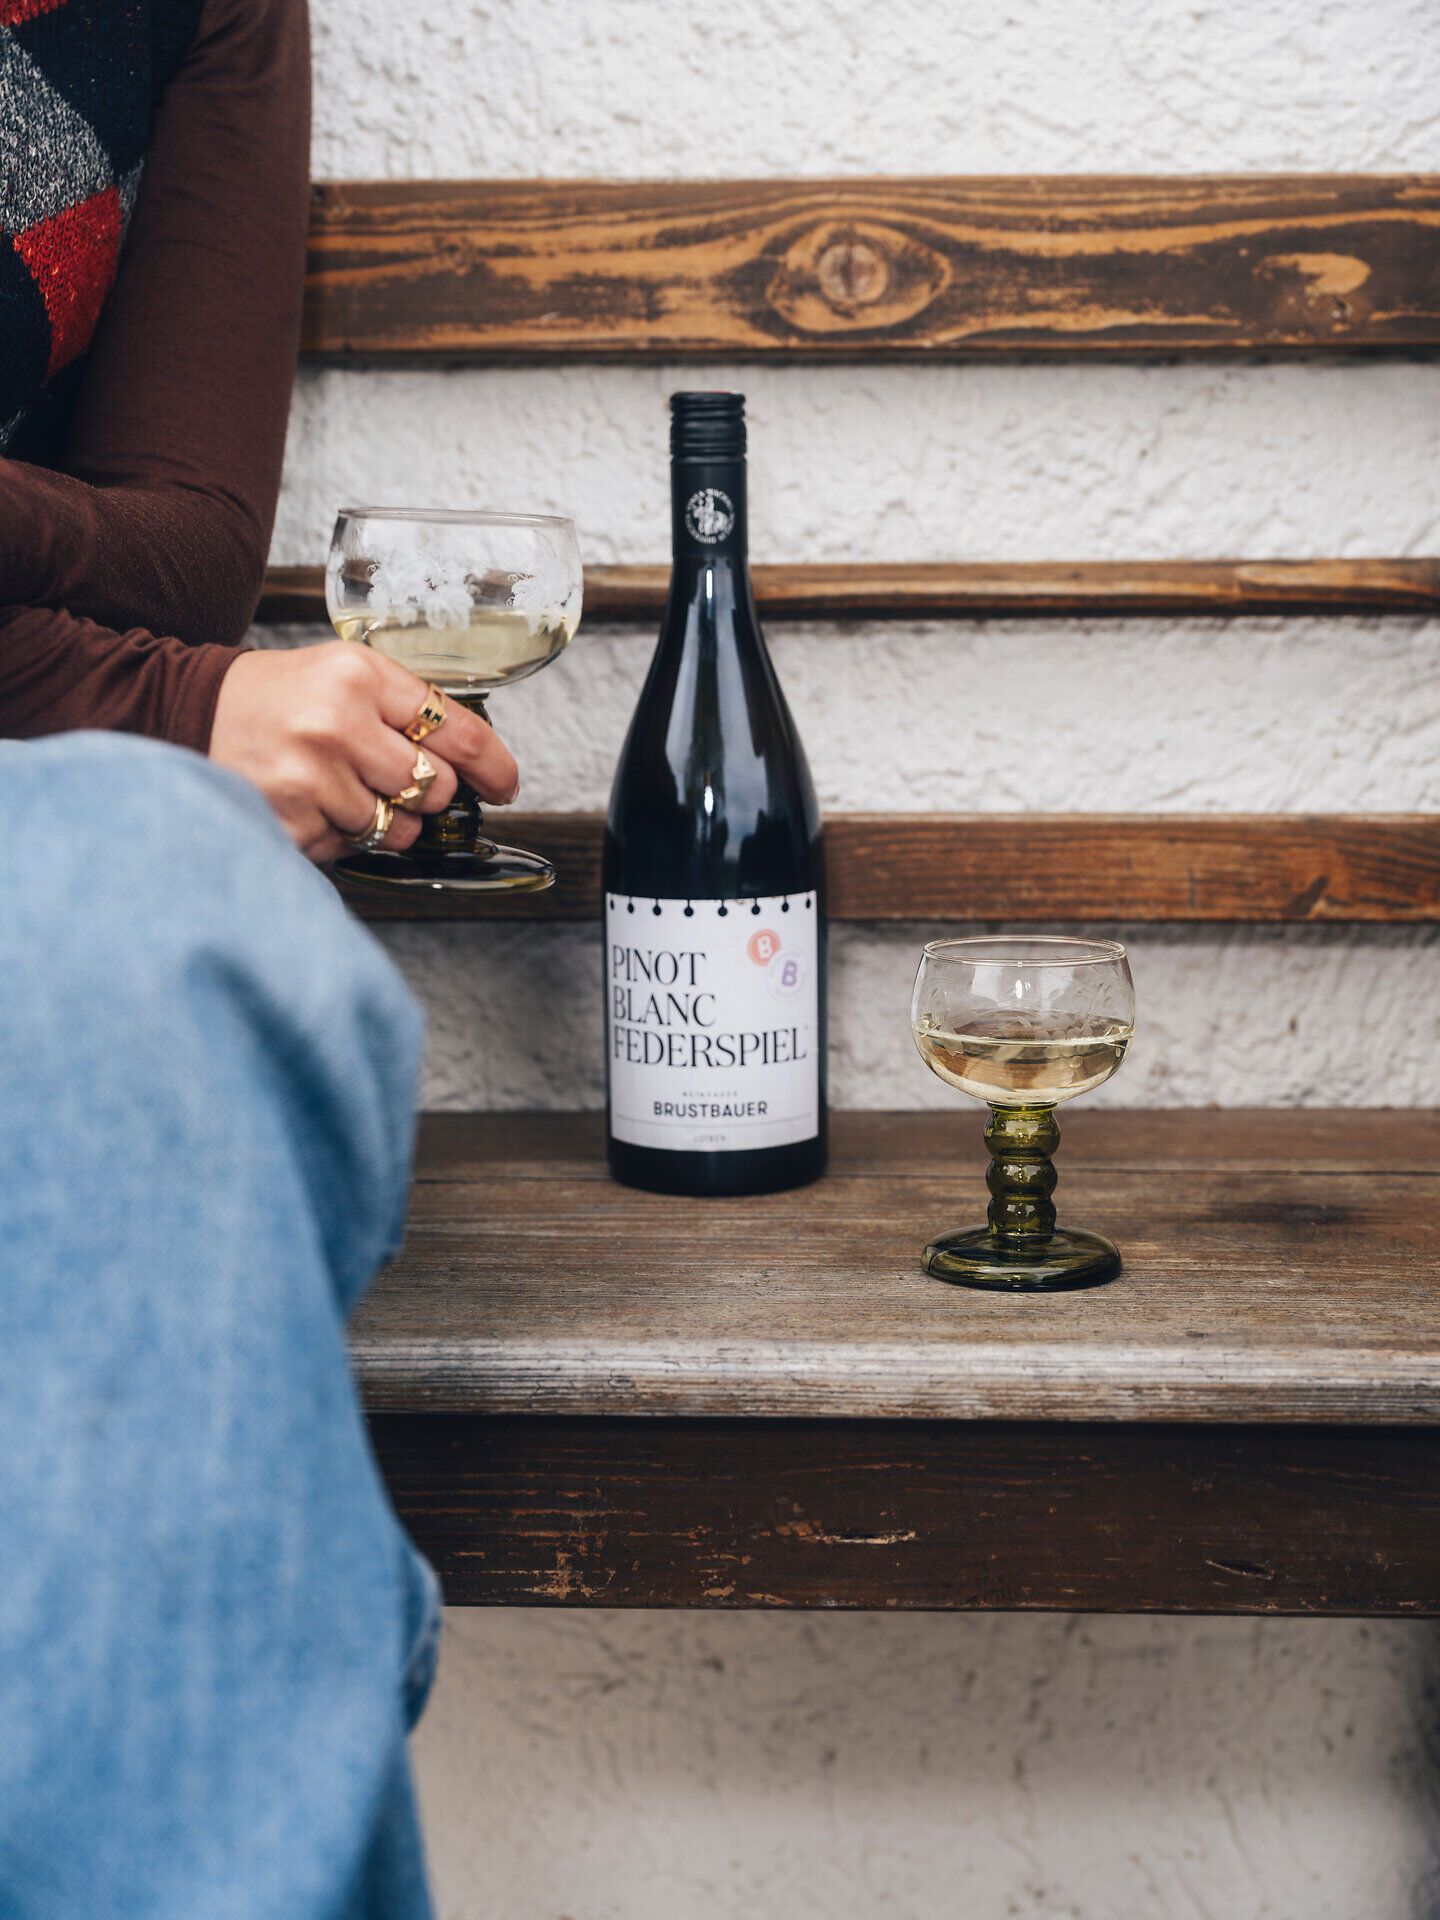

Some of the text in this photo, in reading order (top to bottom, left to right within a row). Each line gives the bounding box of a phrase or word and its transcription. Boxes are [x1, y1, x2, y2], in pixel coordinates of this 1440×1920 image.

[757, 935, 772, 959] B
[612, 945, 706, 986] PINOT
[782, 959, 797, 986] B
[613, 985, 715, 1027] BLANC
[614, 1027, 807, 1067] FEDERSPIEL
[654, 1101, 768, 1118] BRUSTBAUER
